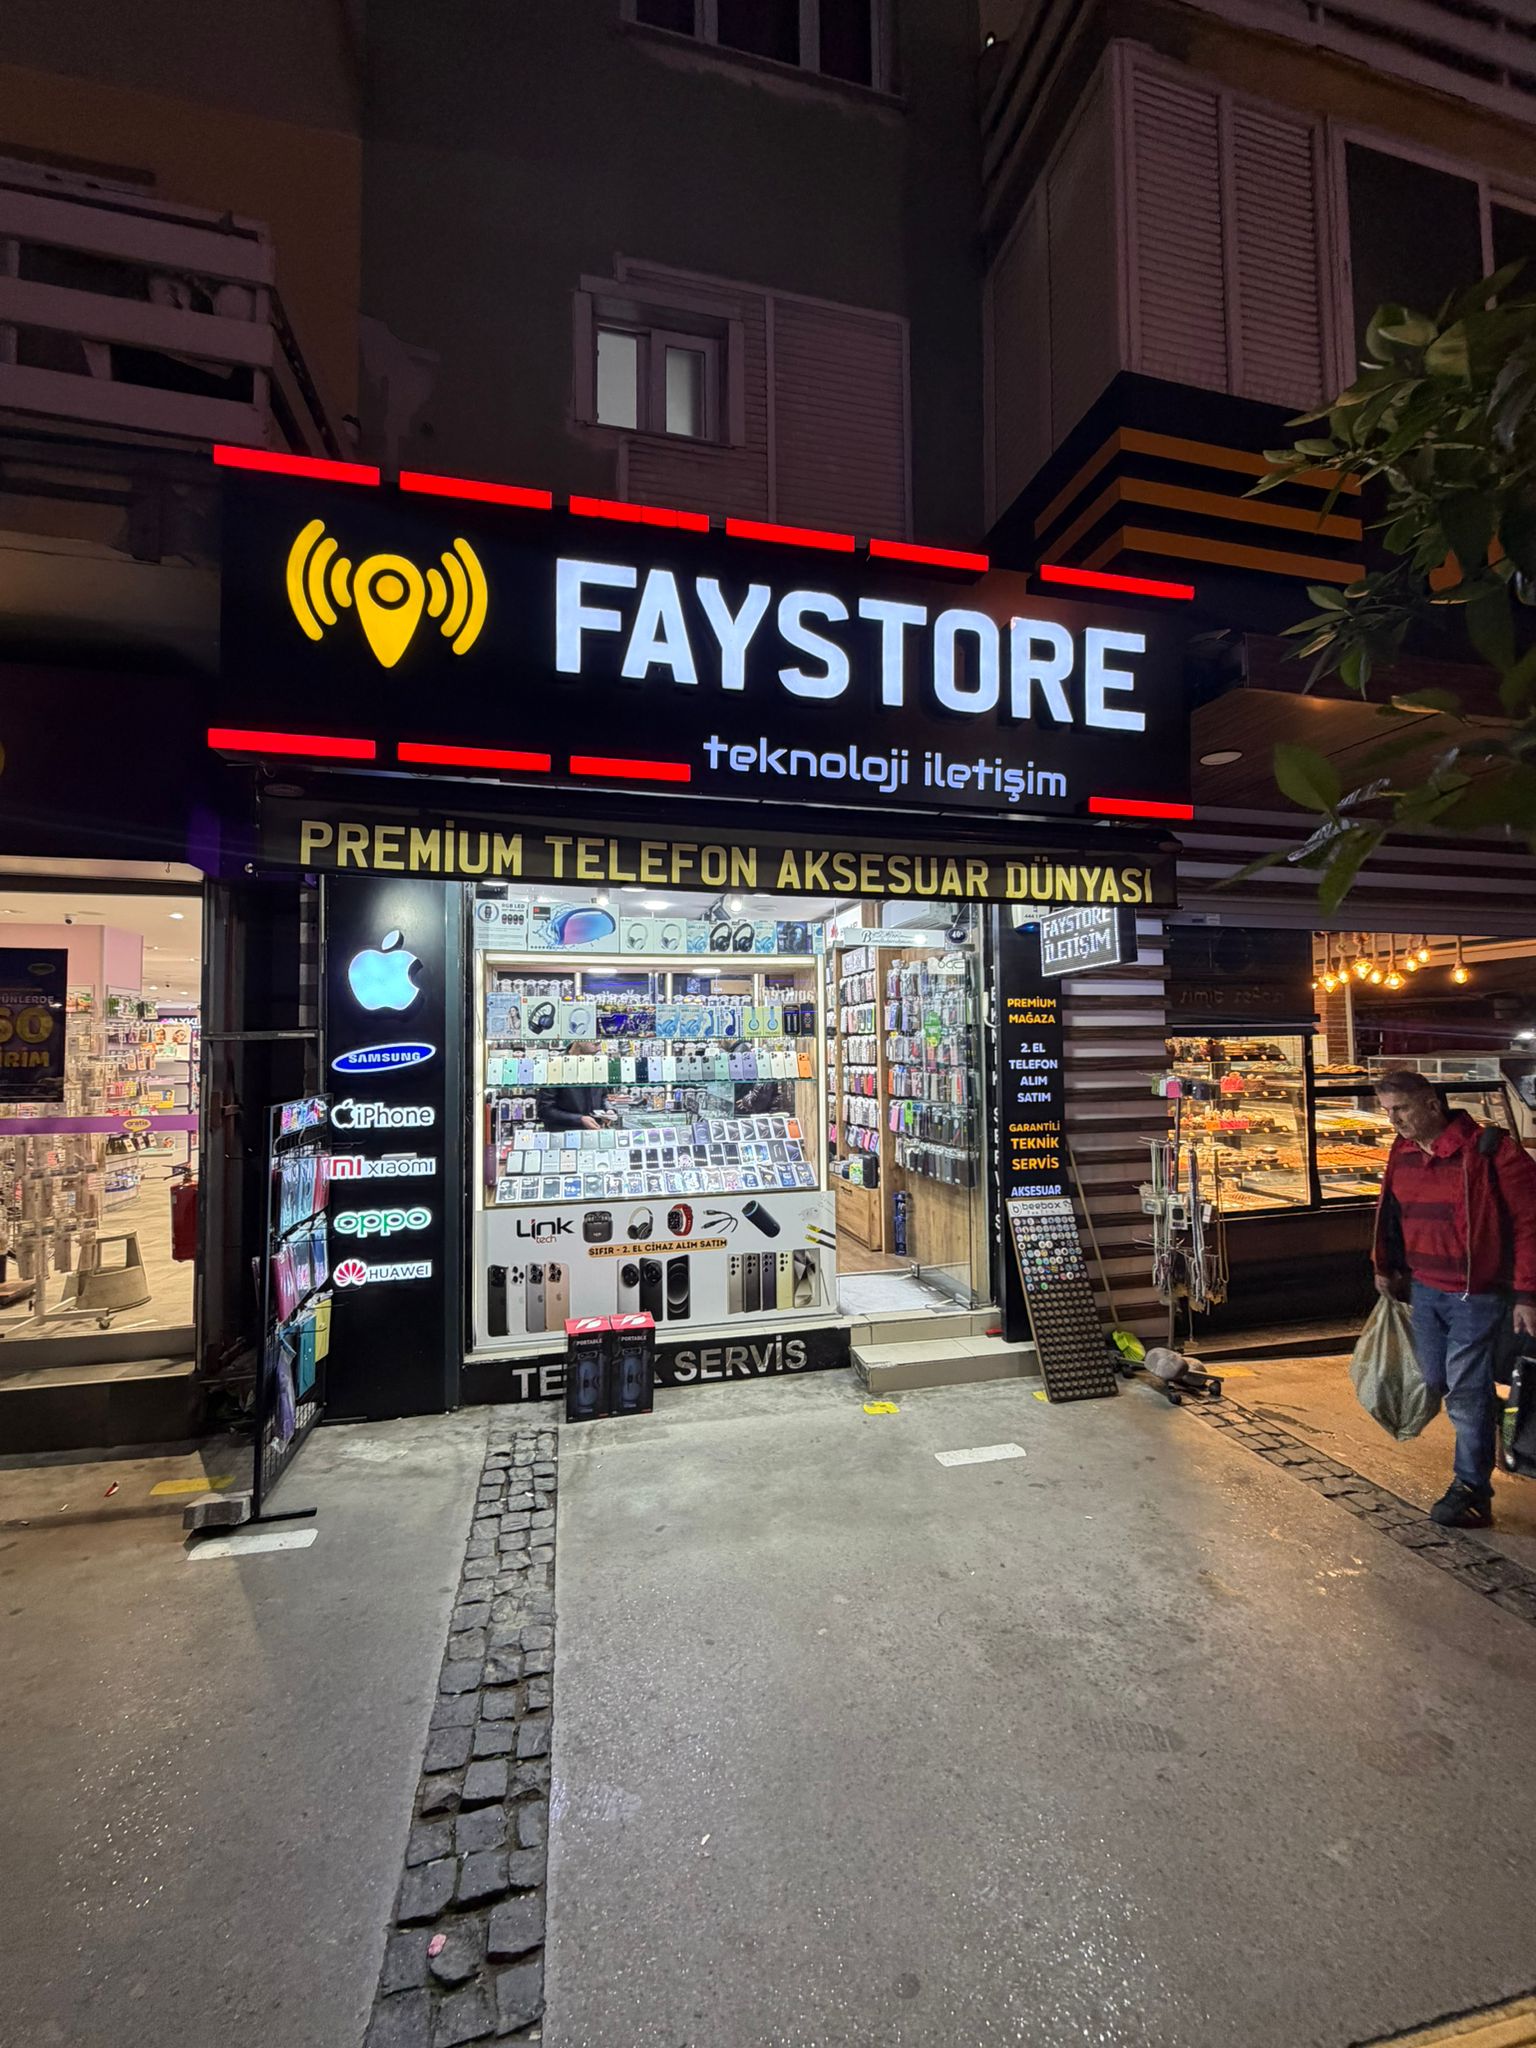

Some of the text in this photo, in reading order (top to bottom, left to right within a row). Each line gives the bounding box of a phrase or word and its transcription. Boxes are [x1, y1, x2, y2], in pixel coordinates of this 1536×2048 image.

[556, 558, 1146, 731] FAYSTORE
[703, 735, 1067, 802] teknoloji iletişim
[300, 819, 1154, 903] PREMİUM TELEFON AKSESUAR DÜNYASI
[1042, 906, 1112, 940] FAYSTORE
[1044, 928, 1111, 963] İLETİŞİM
[0, 994, 55, 1004] ÜNLERDE
[1007, 996, 1056, 1008] PREMİUM
[1009, 1012, 1056, 1024] MAĞAZA
[1020, 1043, 1046, 1053] 2. EL
[348, 1052, 421, 1064] SAMSUNG
[1009, 1059, 1058, 1070] TELEFON
[1020, 1076, 1048, 1086] ALIM
[1017, 1092, 1051, 1103] SATIM
[357, 1105, 432, 1126] iPhone
[1009, 1120, 1060, 1132] GARANTİLİ
[1010, 1134, 1060, 1150] TEKNİK
[368, 1160, 434, 1176] xiaomi
[1012, 1154, 1060, 1171] SERVİS
[1011, 1185, 1062, 1197] AKSESUAR
[337, 1212, 428, 1236] oppo
[517, 1217, 575, 1240] Link
[536, 1235, 557, 1244] tech
[589, 1247, 614, 1256] SIFIR
[623, 1246, 630, 1254] 2.
[645, 1242, 673, 1252] CİHAZ
[676, 1240, 697, 1249] ALIM
[700, 1239, 727, 1248] SATIM
[369, 1264, 429, 1280] HUAWEI
[576, 1338, 602, 1346] PORTABLE
[674, 1335, 808, 1382] SERVİS
